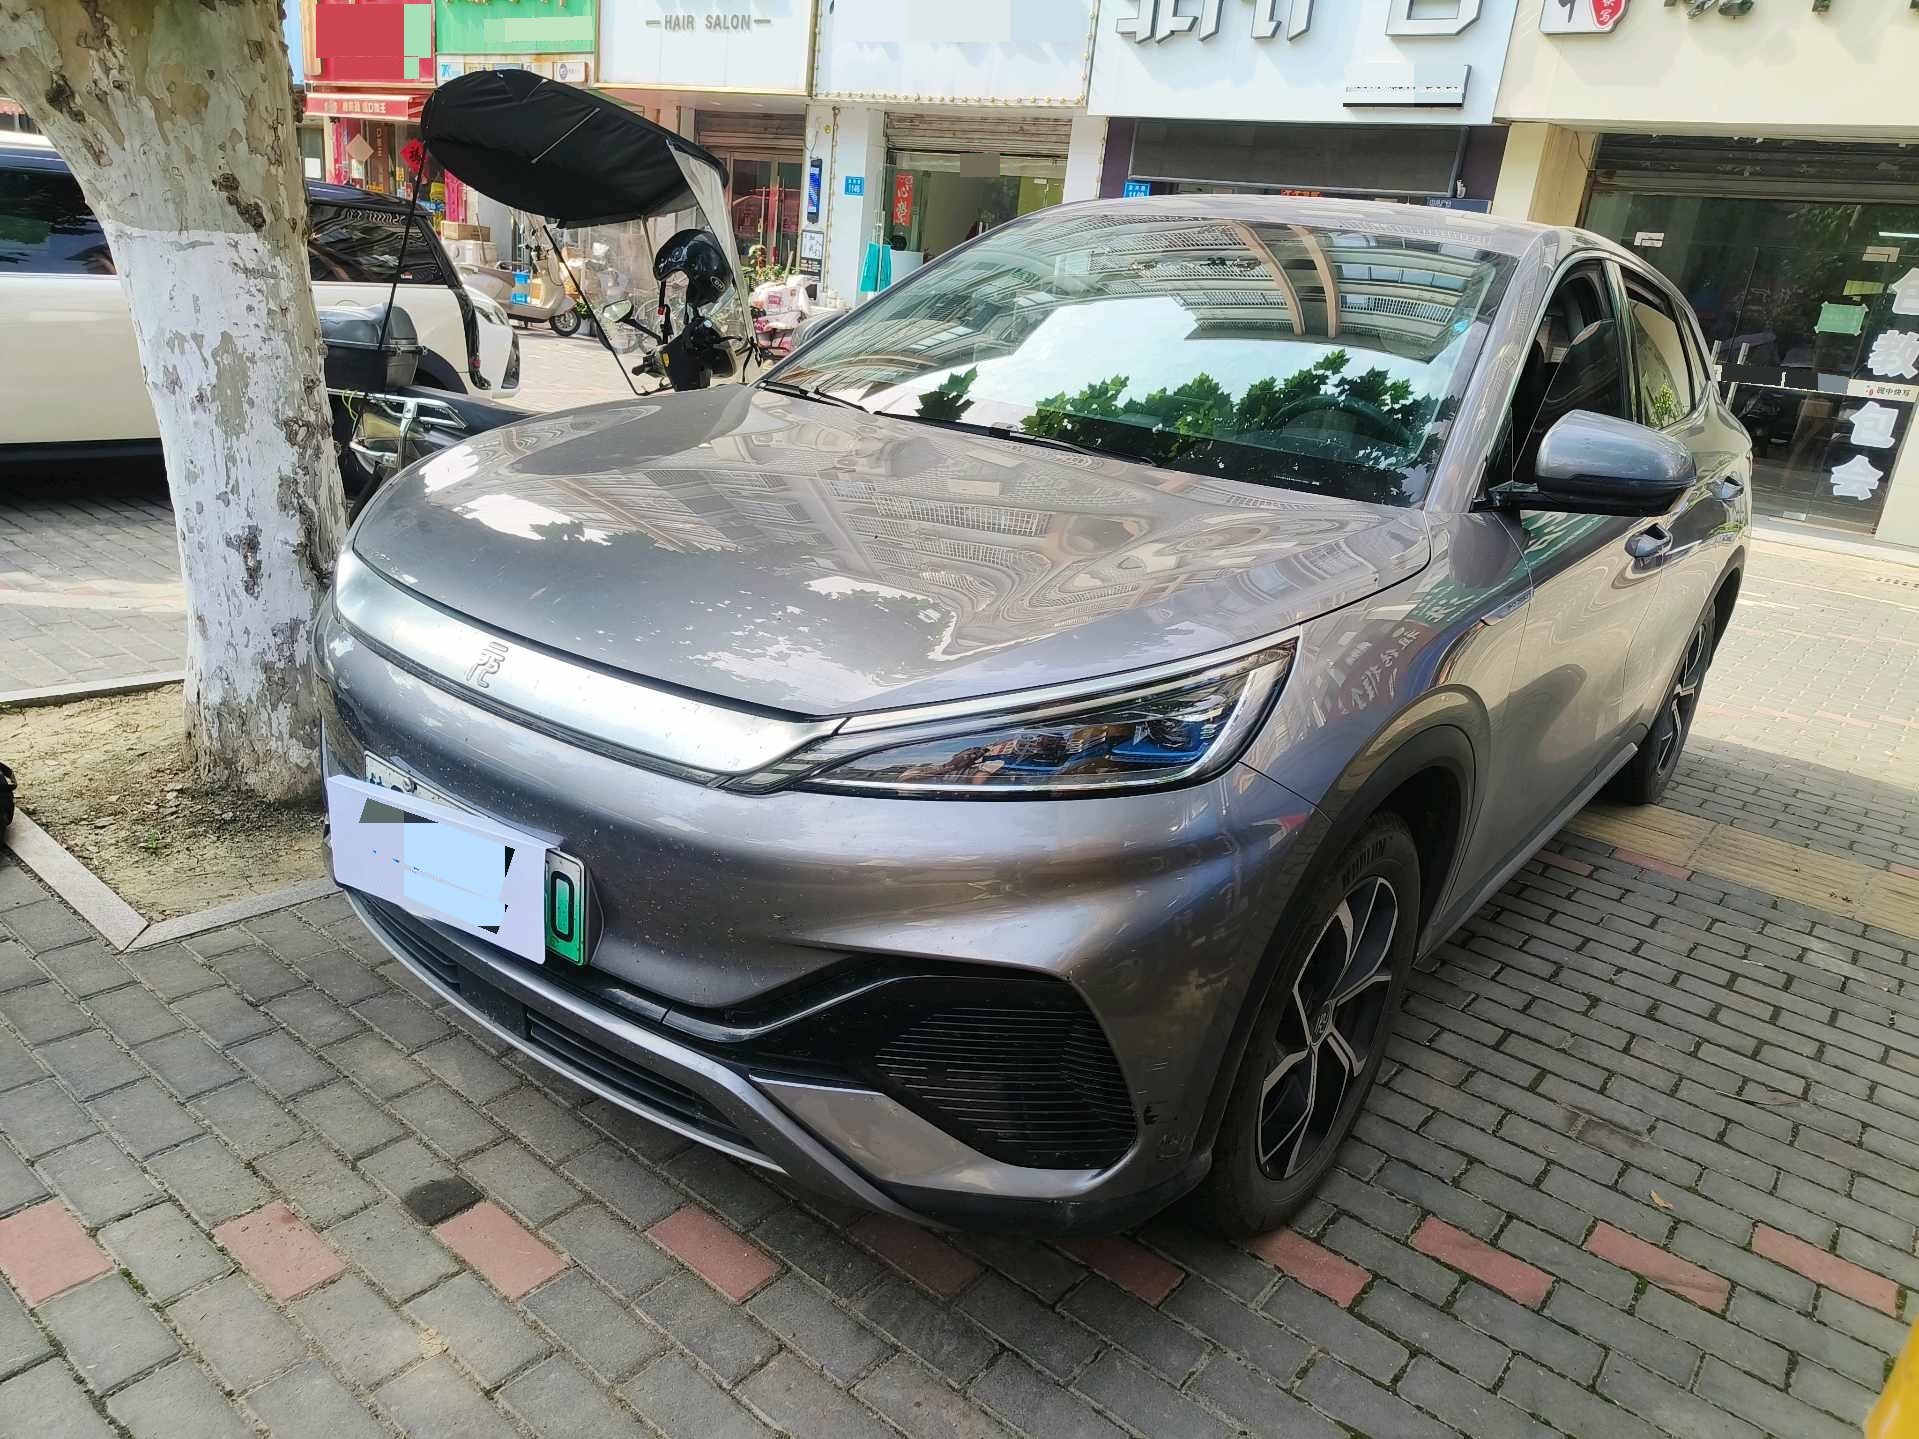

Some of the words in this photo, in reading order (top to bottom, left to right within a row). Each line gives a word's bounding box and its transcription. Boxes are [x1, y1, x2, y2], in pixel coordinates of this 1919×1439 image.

[664, 14, 695, 31] HAIR
[705, 14, 752, 31] SALON
[465, 641, 509, 689] 元
